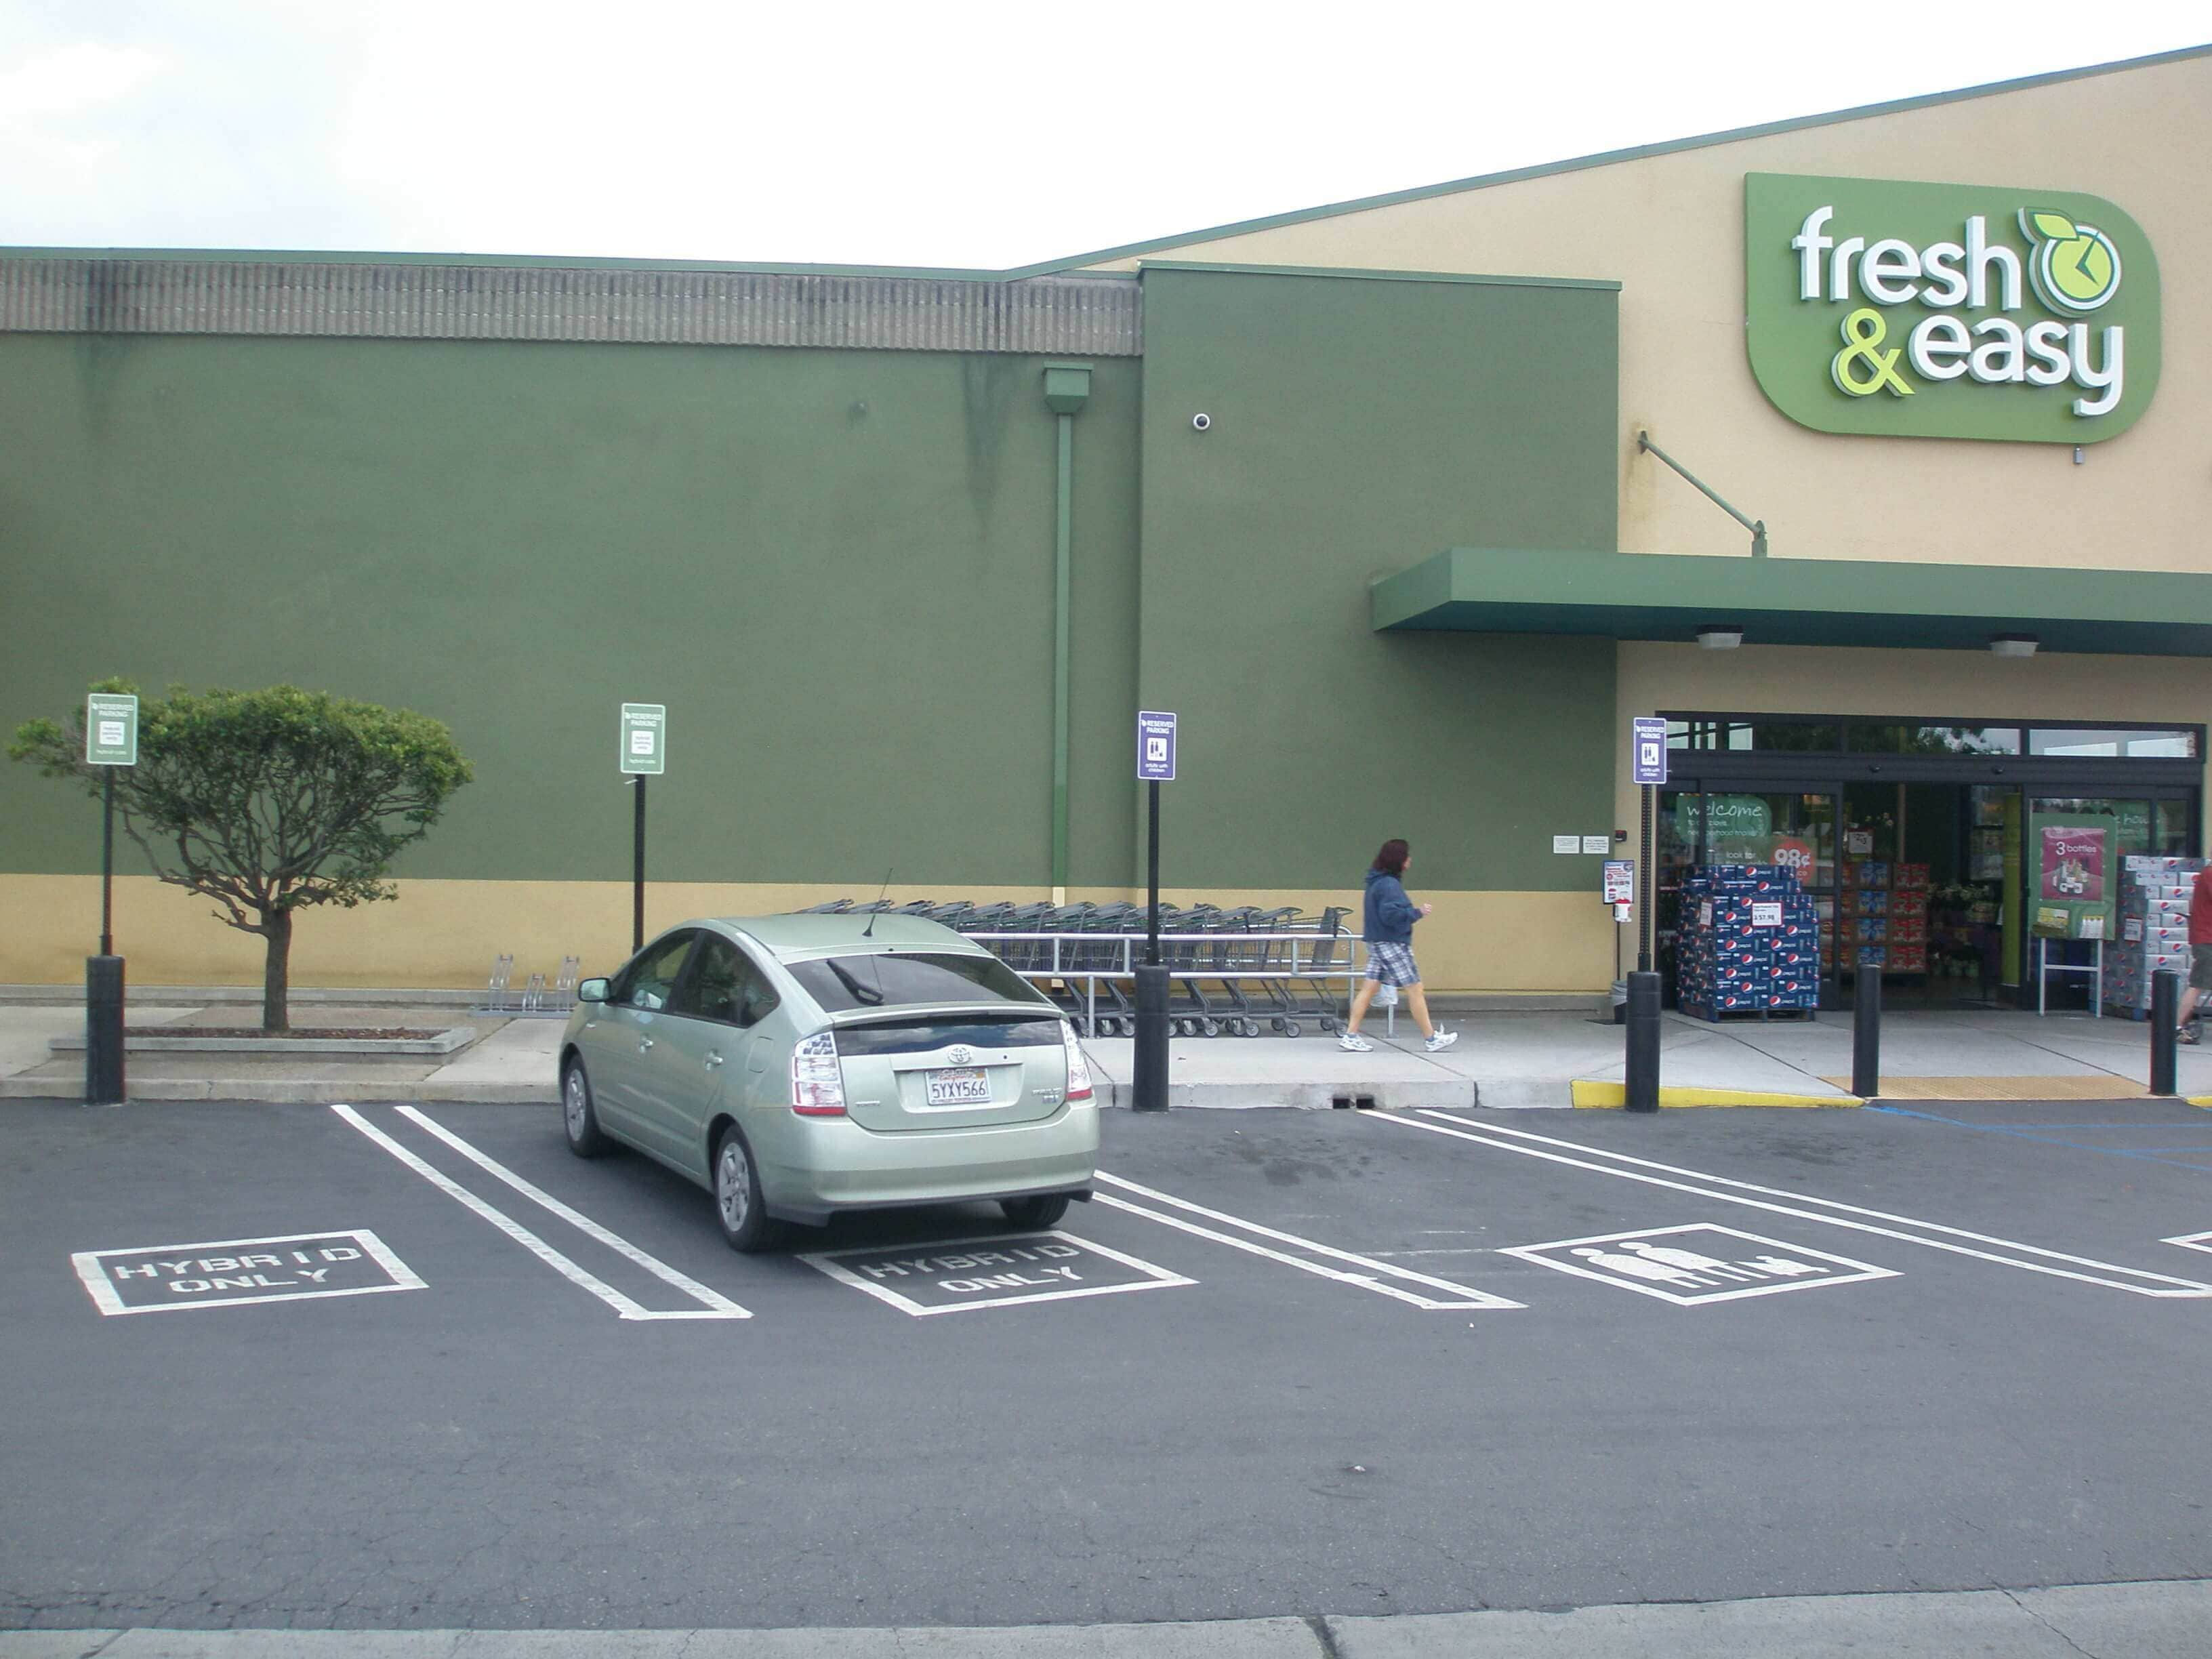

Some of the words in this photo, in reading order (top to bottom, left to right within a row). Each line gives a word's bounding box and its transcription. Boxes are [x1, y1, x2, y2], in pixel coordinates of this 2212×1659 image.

[1791, 205, 2022, 310] fresh
[1831, 308, 1916, 398] &
[1908, 314, 2124, 417] easy
[1774, 848, 1810, 869] 98¢
[2055, 841, 2066, 856] 3
[2067, 844, 2097, 853] bottles
[932, 1081, 987, 1099] 5YXY566
[114, 1246, 363, 1279] HYBRID
[859, 1244, 1081, 1279] HYBRID
[169, 1268, 329, 1293] ONLY
[937, 1266, 1084, 1292] ONLY
